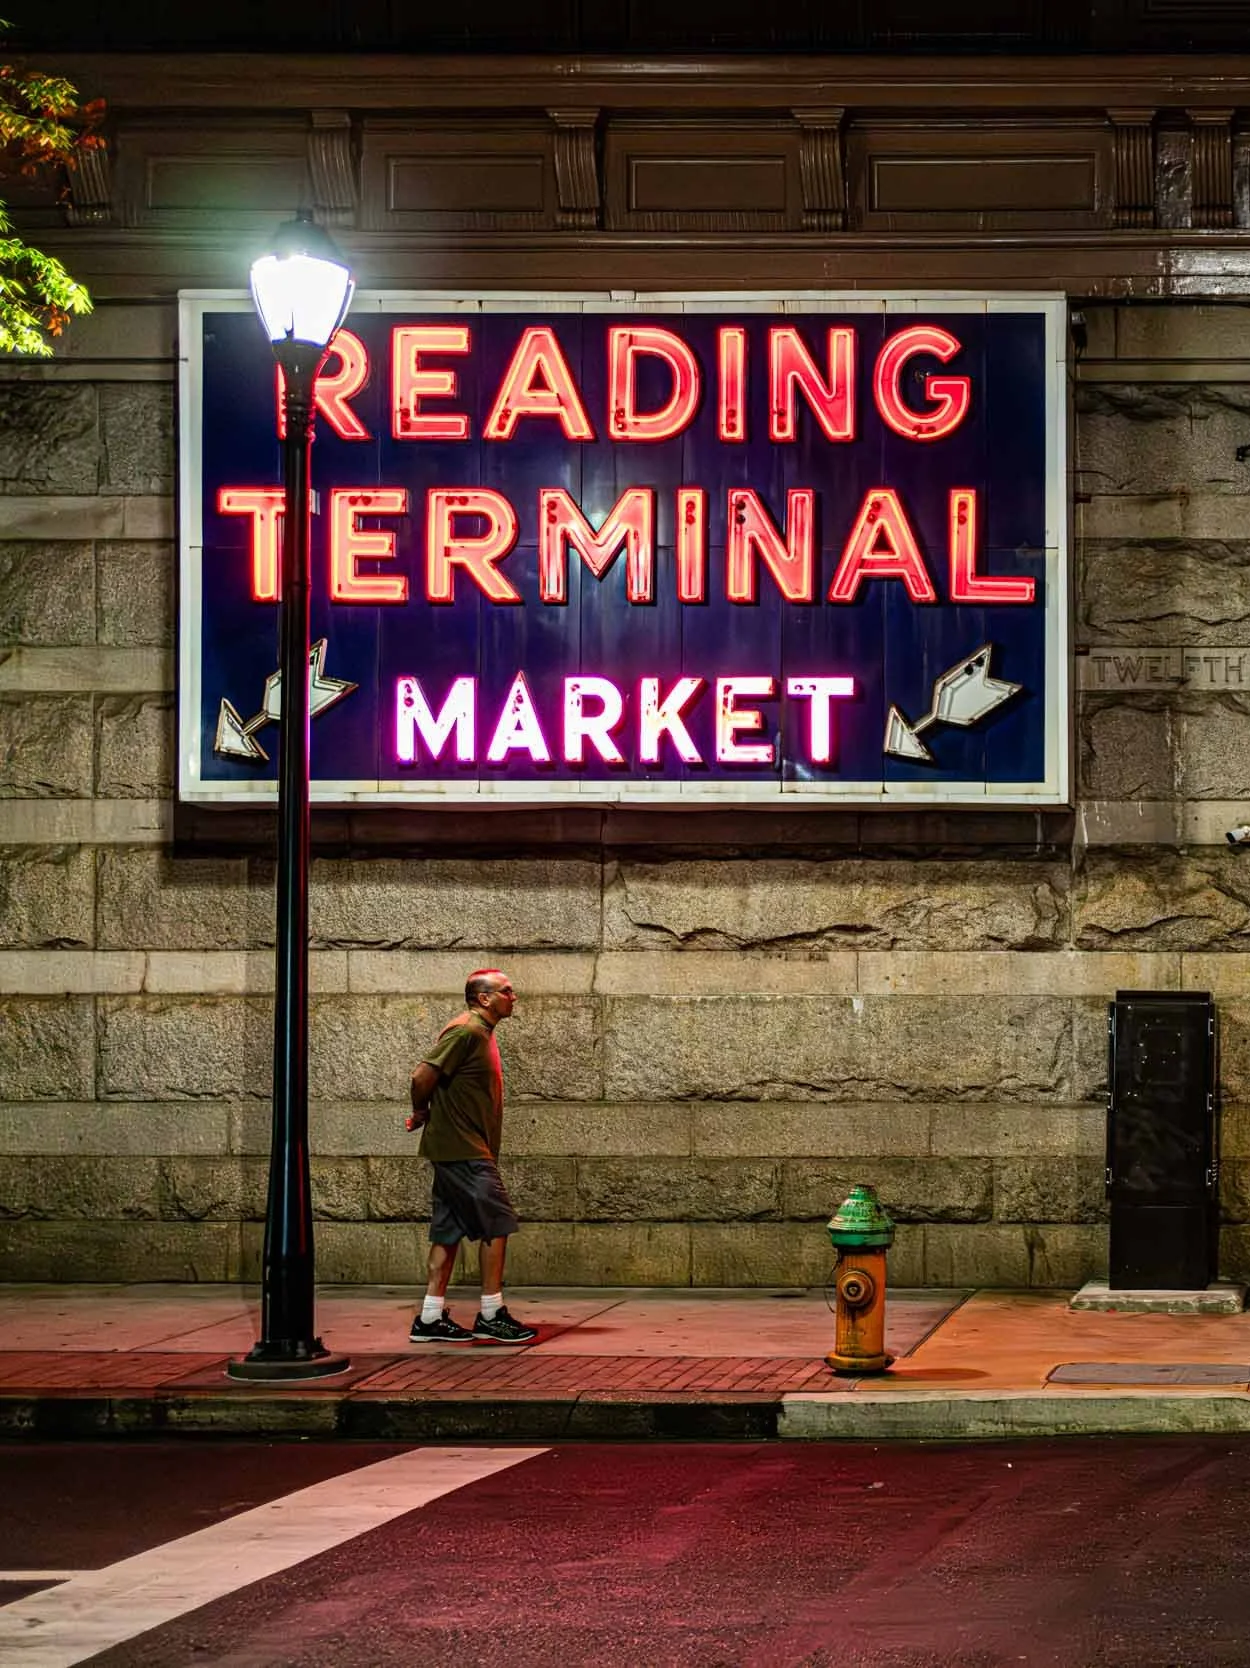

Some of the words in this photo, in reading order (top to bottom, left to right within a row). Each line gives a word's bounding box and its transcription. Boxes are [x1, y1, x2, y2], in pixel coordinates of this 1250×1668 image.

[277, 326, 973, 442] READING
[216, 487, 1038, 604] TERMINAL
[395, 672, 855, 764] MARKET
[1091, 655, 1244, 684] TWELFTH
